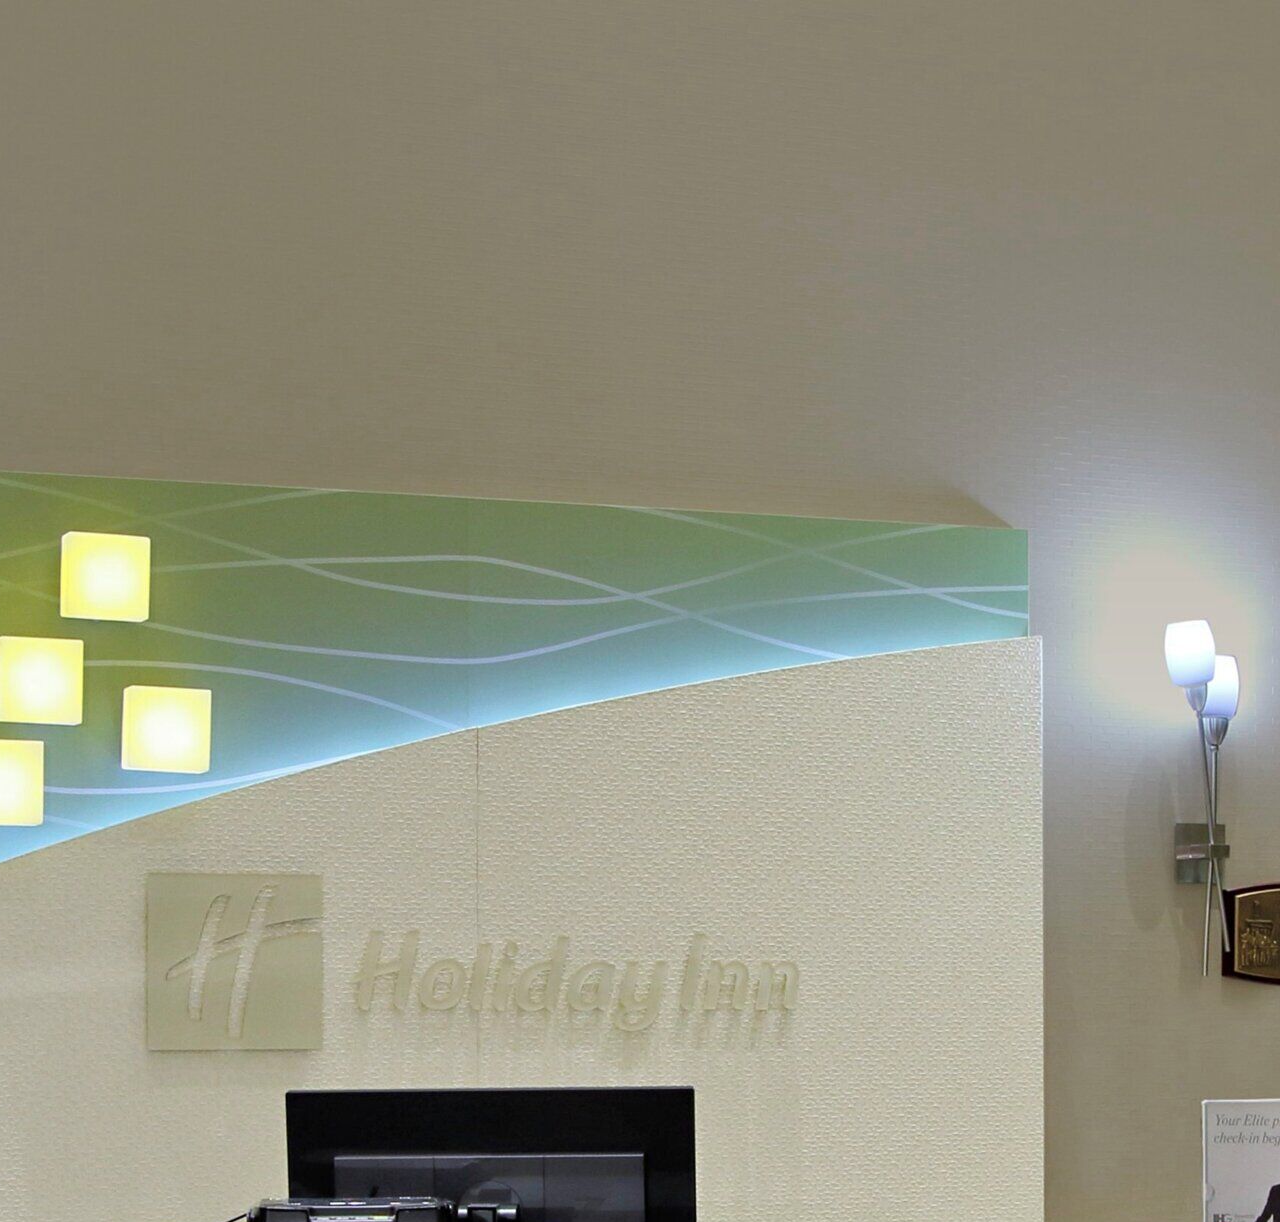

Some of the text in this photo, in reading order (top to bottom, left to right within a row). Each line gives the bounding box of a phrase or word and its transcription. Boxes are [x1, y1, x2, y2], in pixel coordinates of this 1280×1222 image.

[354, 930, 799, 1031] Holiday Inn
[1216, 1114, 1240, 1126] Your
[1244, 1114, 1270, 1126] Elite
[1214, 1132, 1260, 1144] check-in
